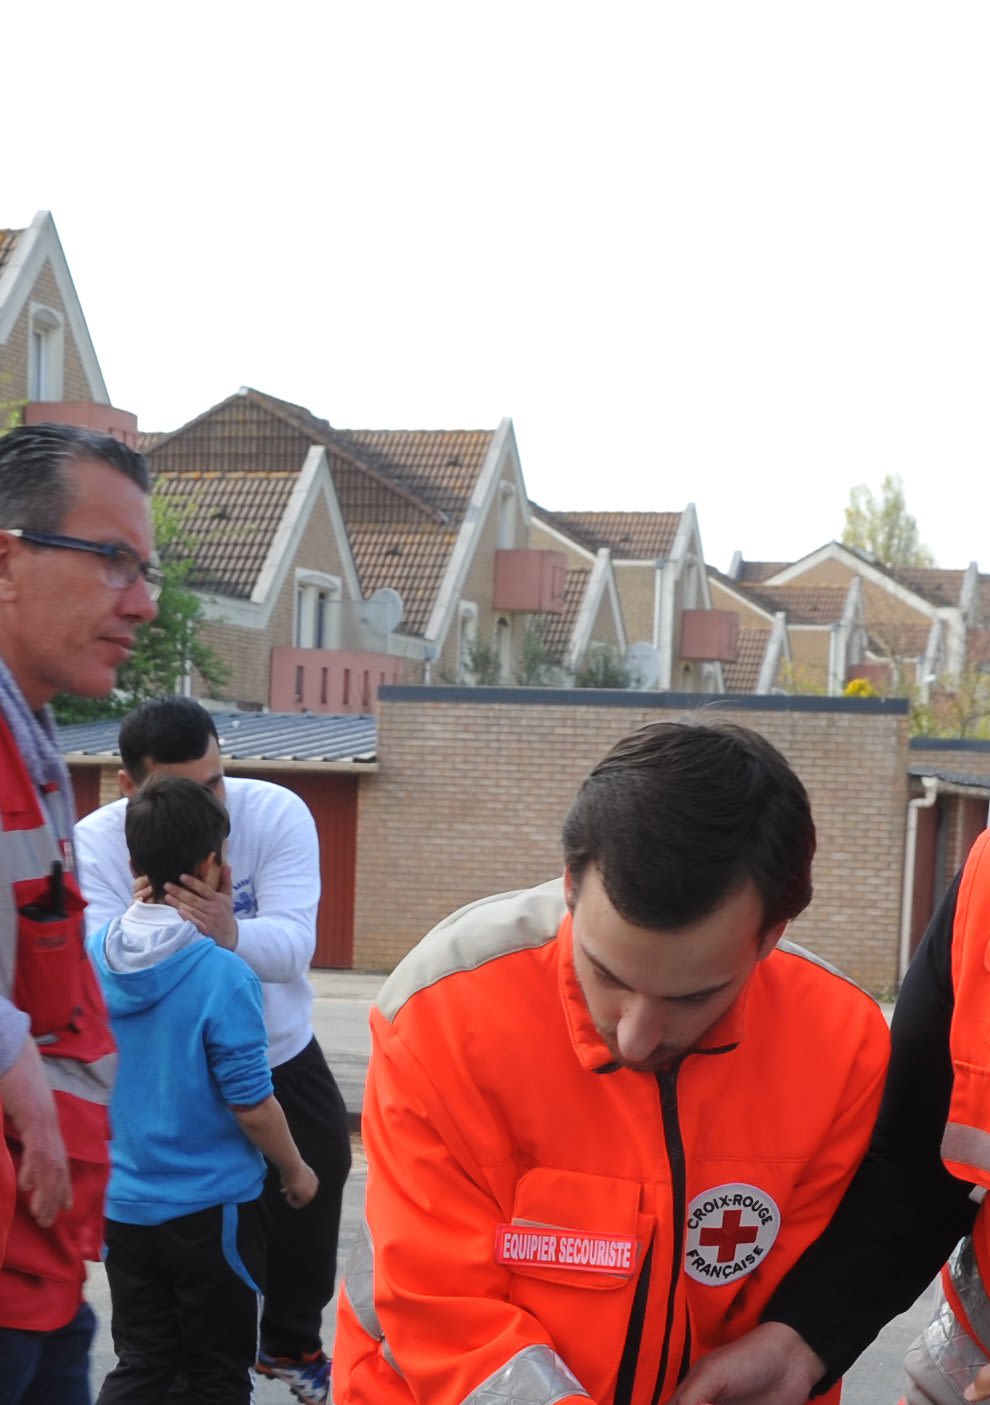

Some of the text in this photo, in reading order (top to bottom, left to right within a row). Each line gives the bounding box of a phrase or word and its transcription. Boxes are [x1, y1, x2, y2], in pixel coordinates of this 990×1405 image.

[687, 1193, 773, 1229] CROIX-ROUGE
[503, 1233, 631, 1268] EQUIPIER SECOURISTE
[686, 1245, 763, 1279] FRANÇAISE
